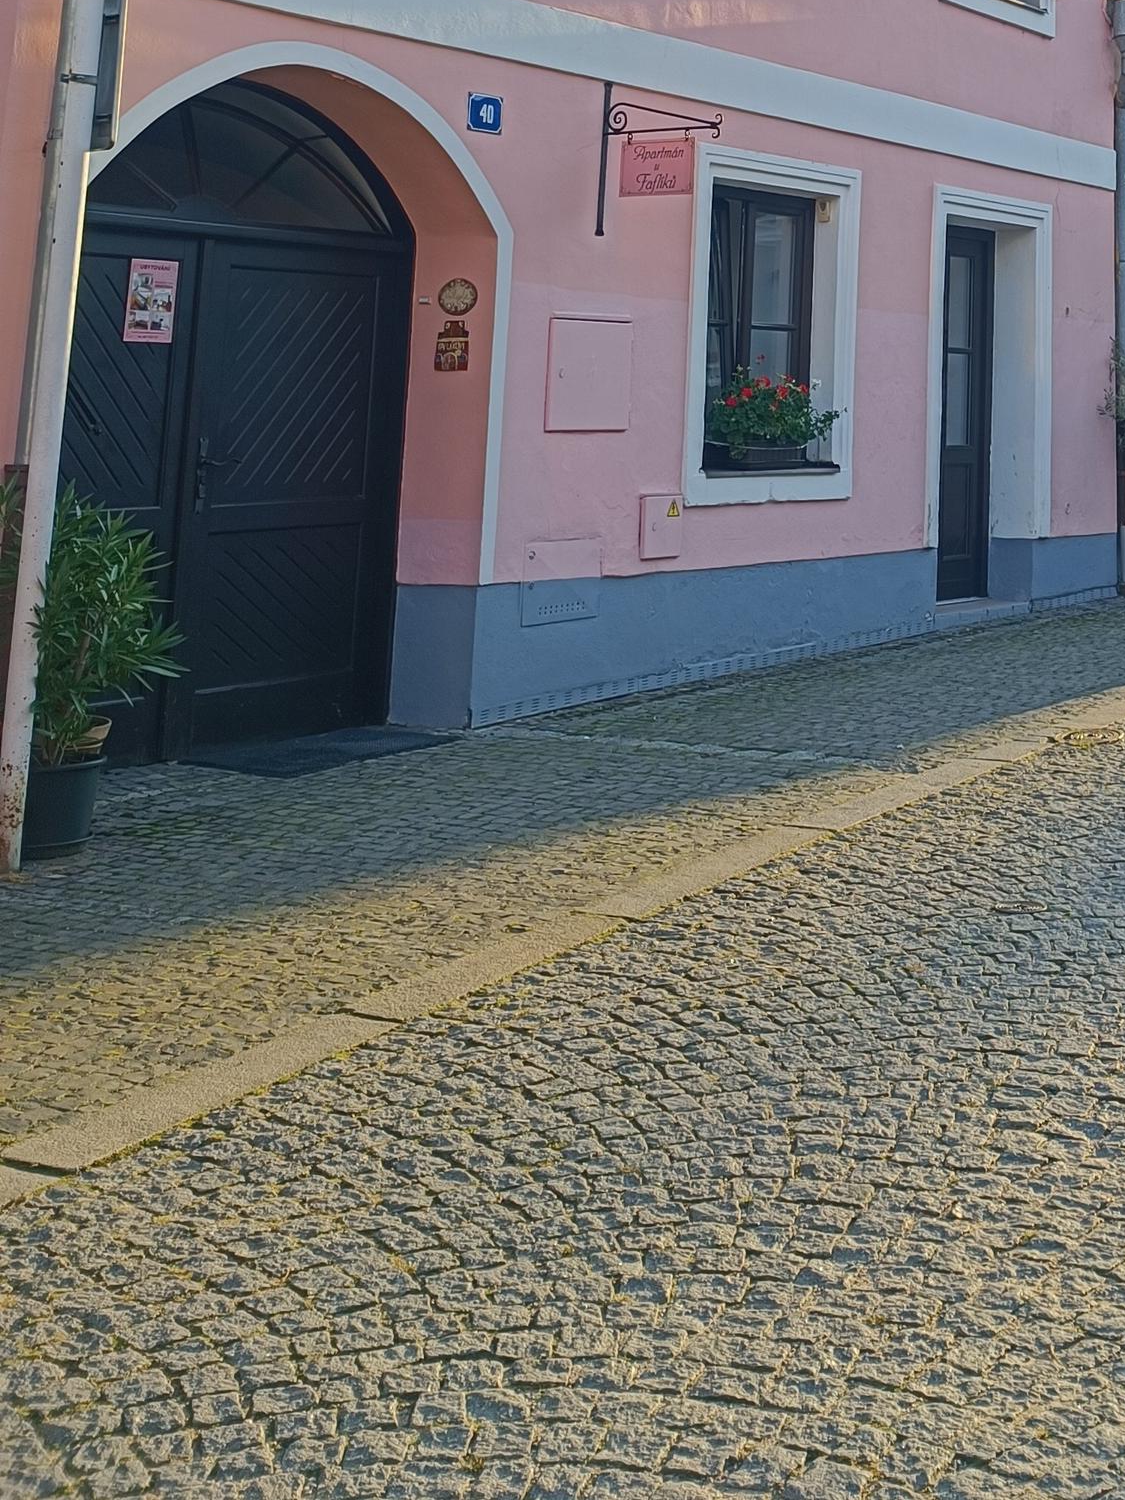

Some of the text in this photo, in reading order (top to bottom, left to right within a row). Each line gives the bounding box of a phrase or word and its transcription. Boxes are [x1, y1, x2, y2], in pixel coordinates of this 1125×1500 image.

[480, 103, 494, 124] 40
[633, 145, 684, 163] Apartmán
[653, 163, 660, 171] u
